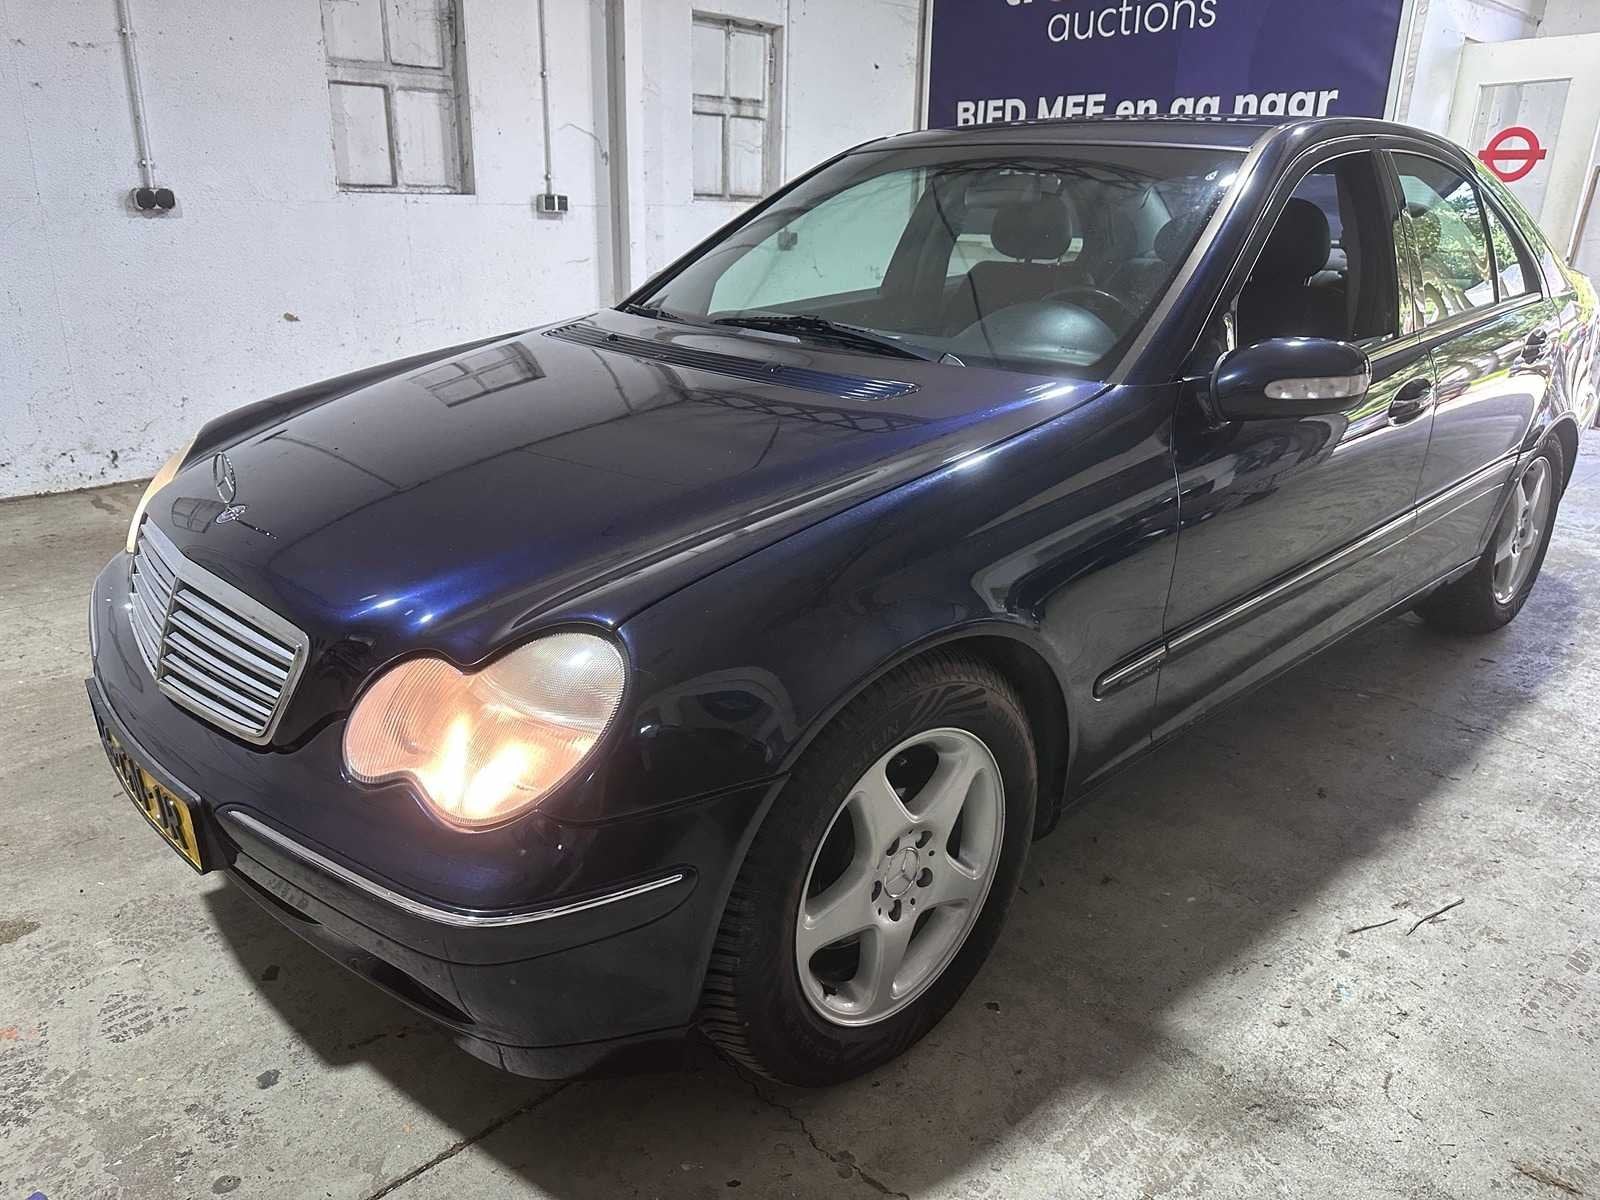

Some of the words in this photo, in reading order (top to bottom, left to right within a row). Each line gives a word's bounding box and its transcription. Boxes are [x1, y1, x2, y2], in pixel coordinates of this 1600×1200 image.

[1047, 0, 1217, 42] auctions
[957, 98, 1026, 127] BIED
[1037, 93, 1106, 120] MEE
[1115, 98, 1157, 116] en
[1234, 89, 1339, 117] naar
